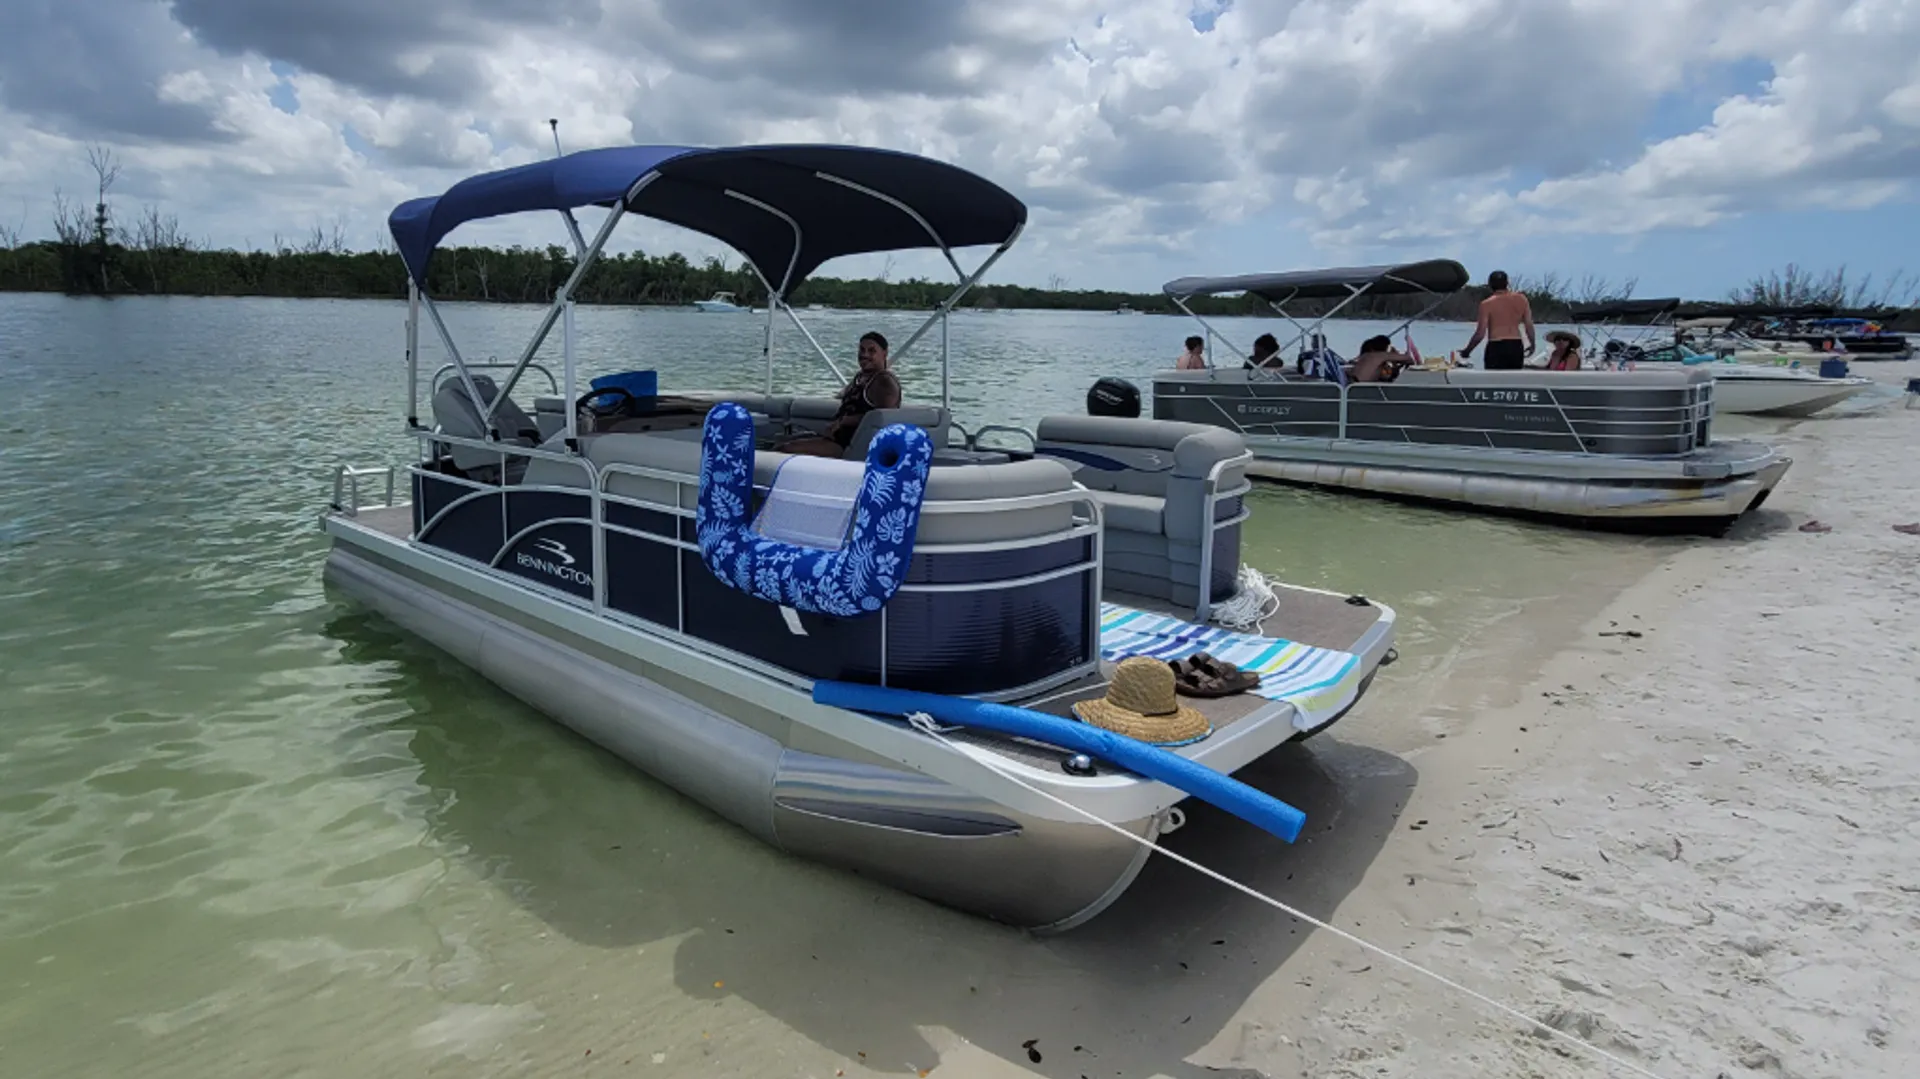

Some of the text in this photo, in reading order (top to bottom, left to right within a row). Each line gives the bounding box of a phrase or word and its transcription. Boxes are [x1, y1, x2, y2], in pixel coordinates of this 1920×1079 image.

[1474, 391, 1539, 402] FL 5767 TE
